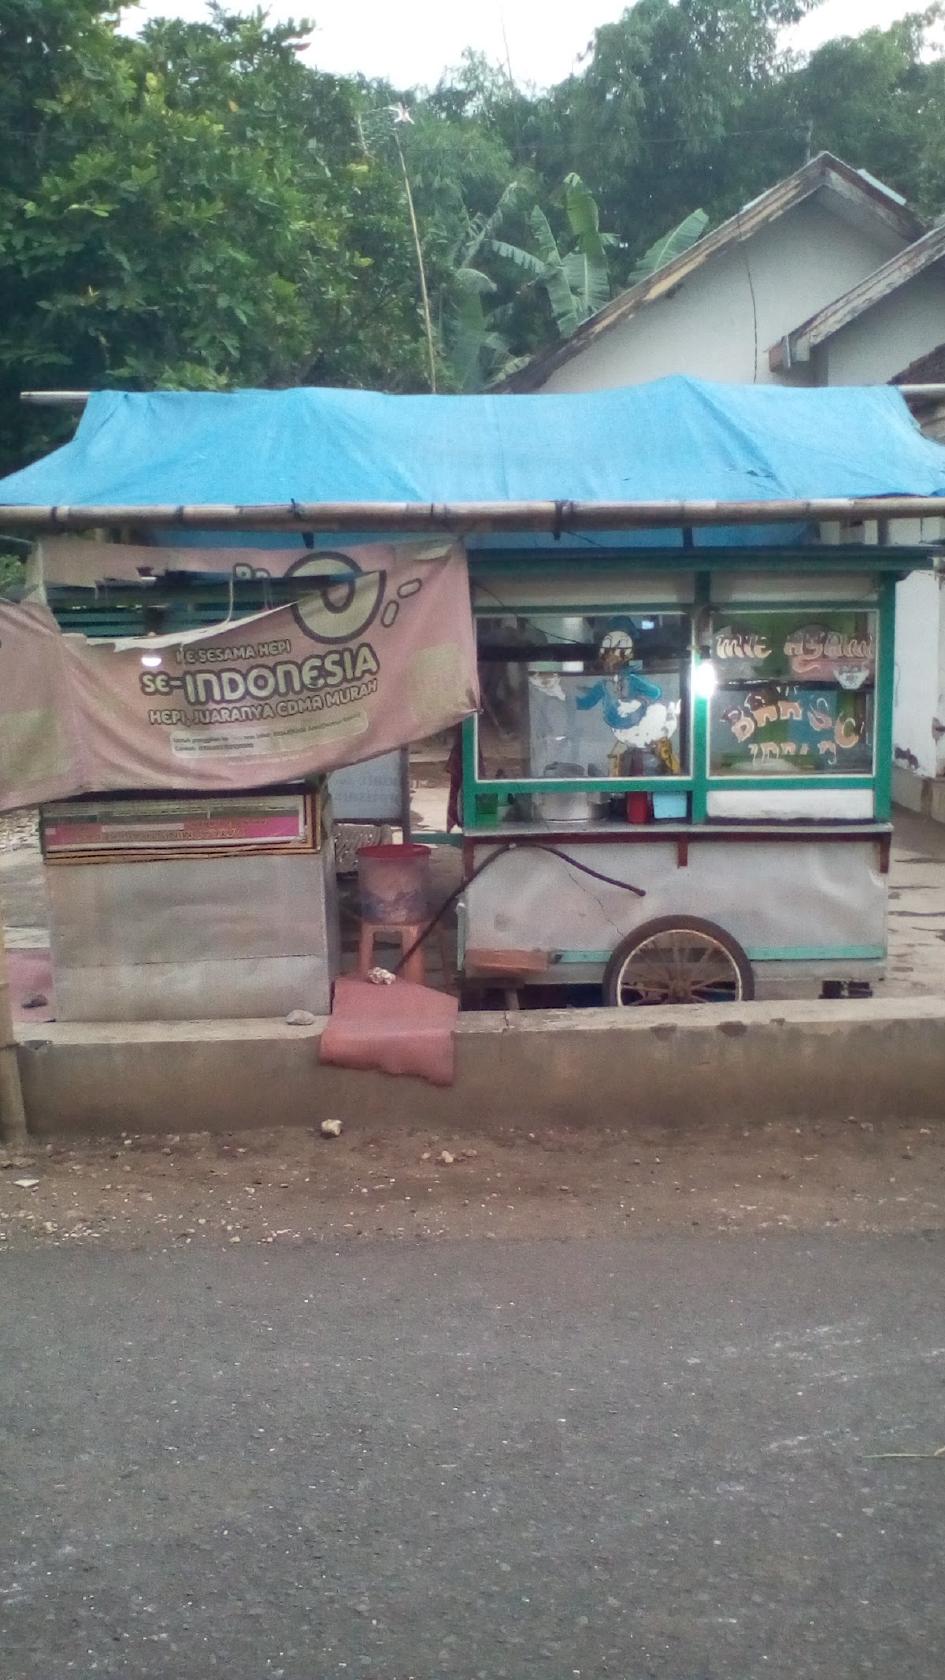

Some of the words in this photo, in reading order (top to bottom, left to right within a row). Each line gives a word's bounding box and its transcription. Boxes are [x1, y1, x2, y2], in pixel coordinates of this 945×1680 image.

[197, 644, 255, 663] SESAMA
[256, 638, 292, 657] HEPI
[192, 702, 275, 725] JUARANYA
[275, 694, 325, 717] CDMA
[324, 678, 378, 709] MURAH
